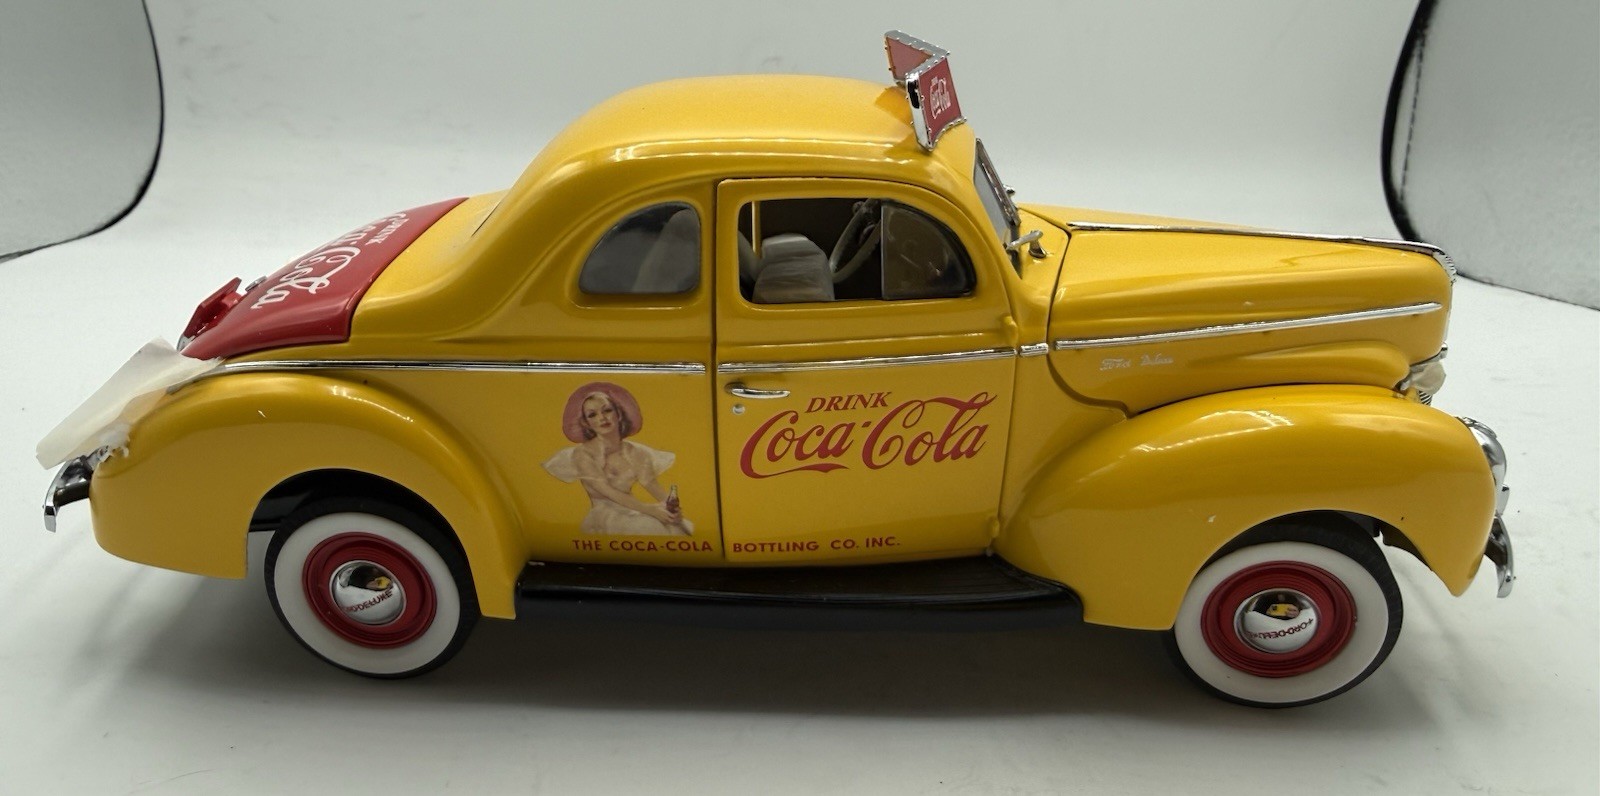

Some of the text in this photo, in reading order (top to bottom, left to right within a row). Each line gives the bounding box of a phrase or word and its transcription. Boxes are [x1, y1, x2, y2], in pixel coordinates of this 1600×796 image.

[805, 392, 892, 413] DRINK
[740, 392, 998, 479] Coca-Cola
[572, 536, 901, 553] THE COCA-COLA BOTTLING CO. INC.
